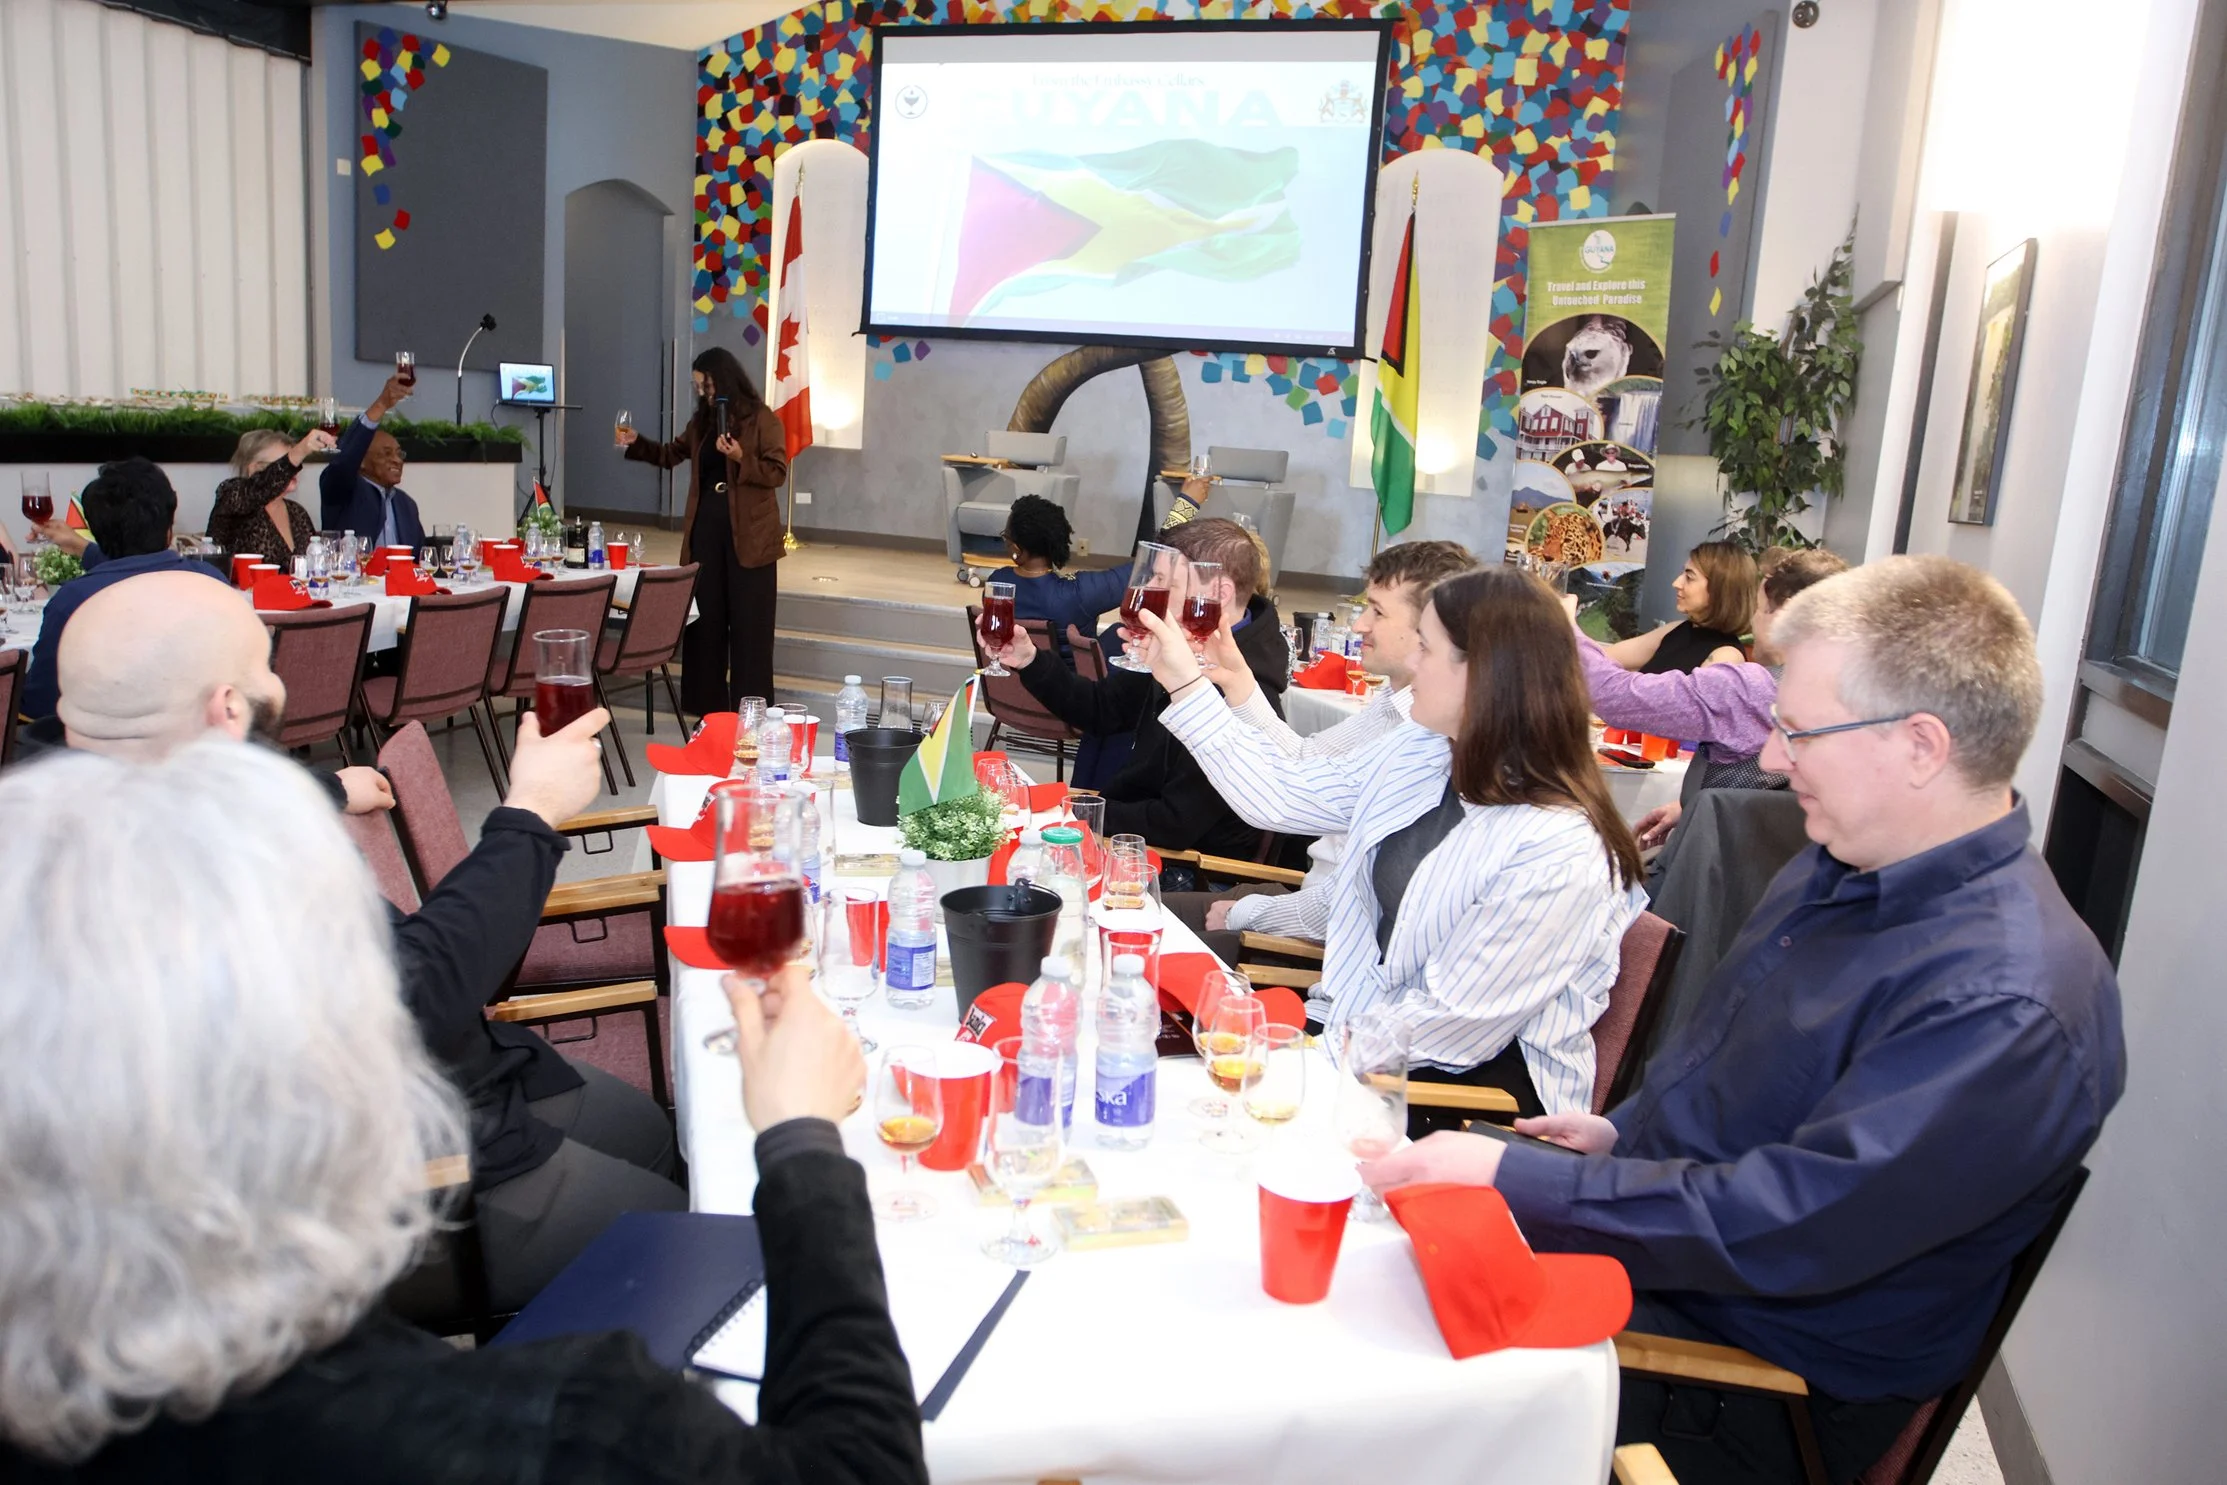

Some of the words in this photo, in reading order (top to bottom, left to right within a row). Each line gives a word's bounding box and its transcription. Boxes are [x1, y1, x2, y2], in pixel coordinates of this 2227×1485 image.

[1547, 281, 1574, 293] Travel
[1575, 281, 1592, 292] and
[1593, 280, 1626, 292] Explore
[1628, 279, 1646, 291] this
[1552, 294, 1600, 306] Untouched
[1602, 293, 1642, 305] Paradise
